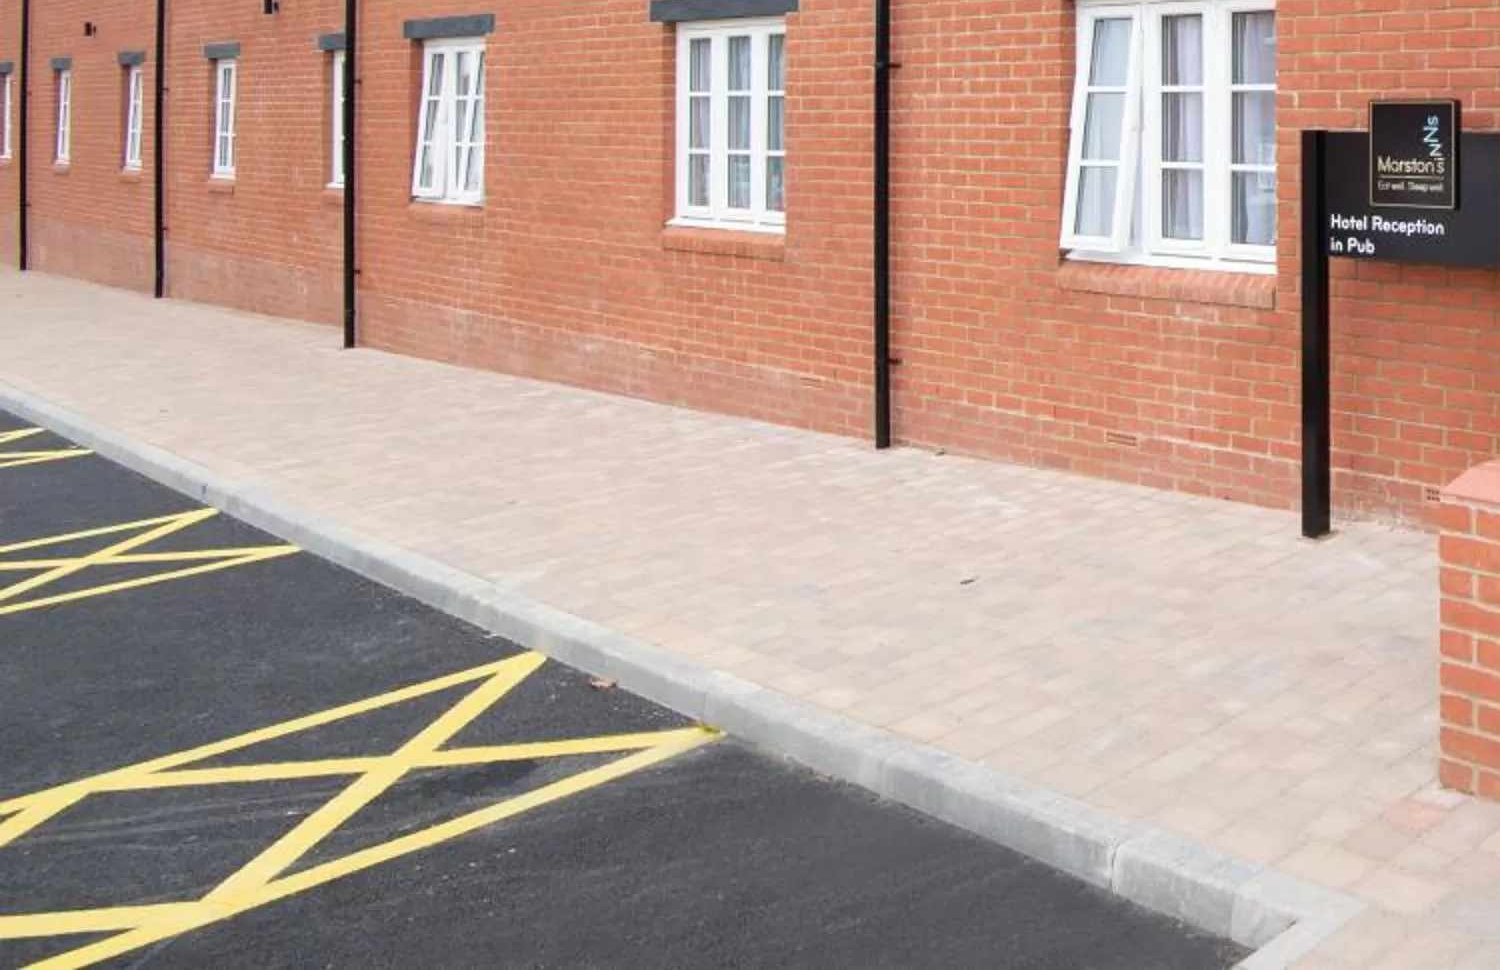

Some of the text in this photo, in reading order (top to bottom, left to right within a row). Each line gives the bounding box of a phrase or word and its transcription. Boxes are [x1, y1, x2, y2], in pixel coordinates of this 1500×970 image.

[1331, 214, 1445, 236] Hotel Reception
[1330, 237, 1375, 254] in Pub
